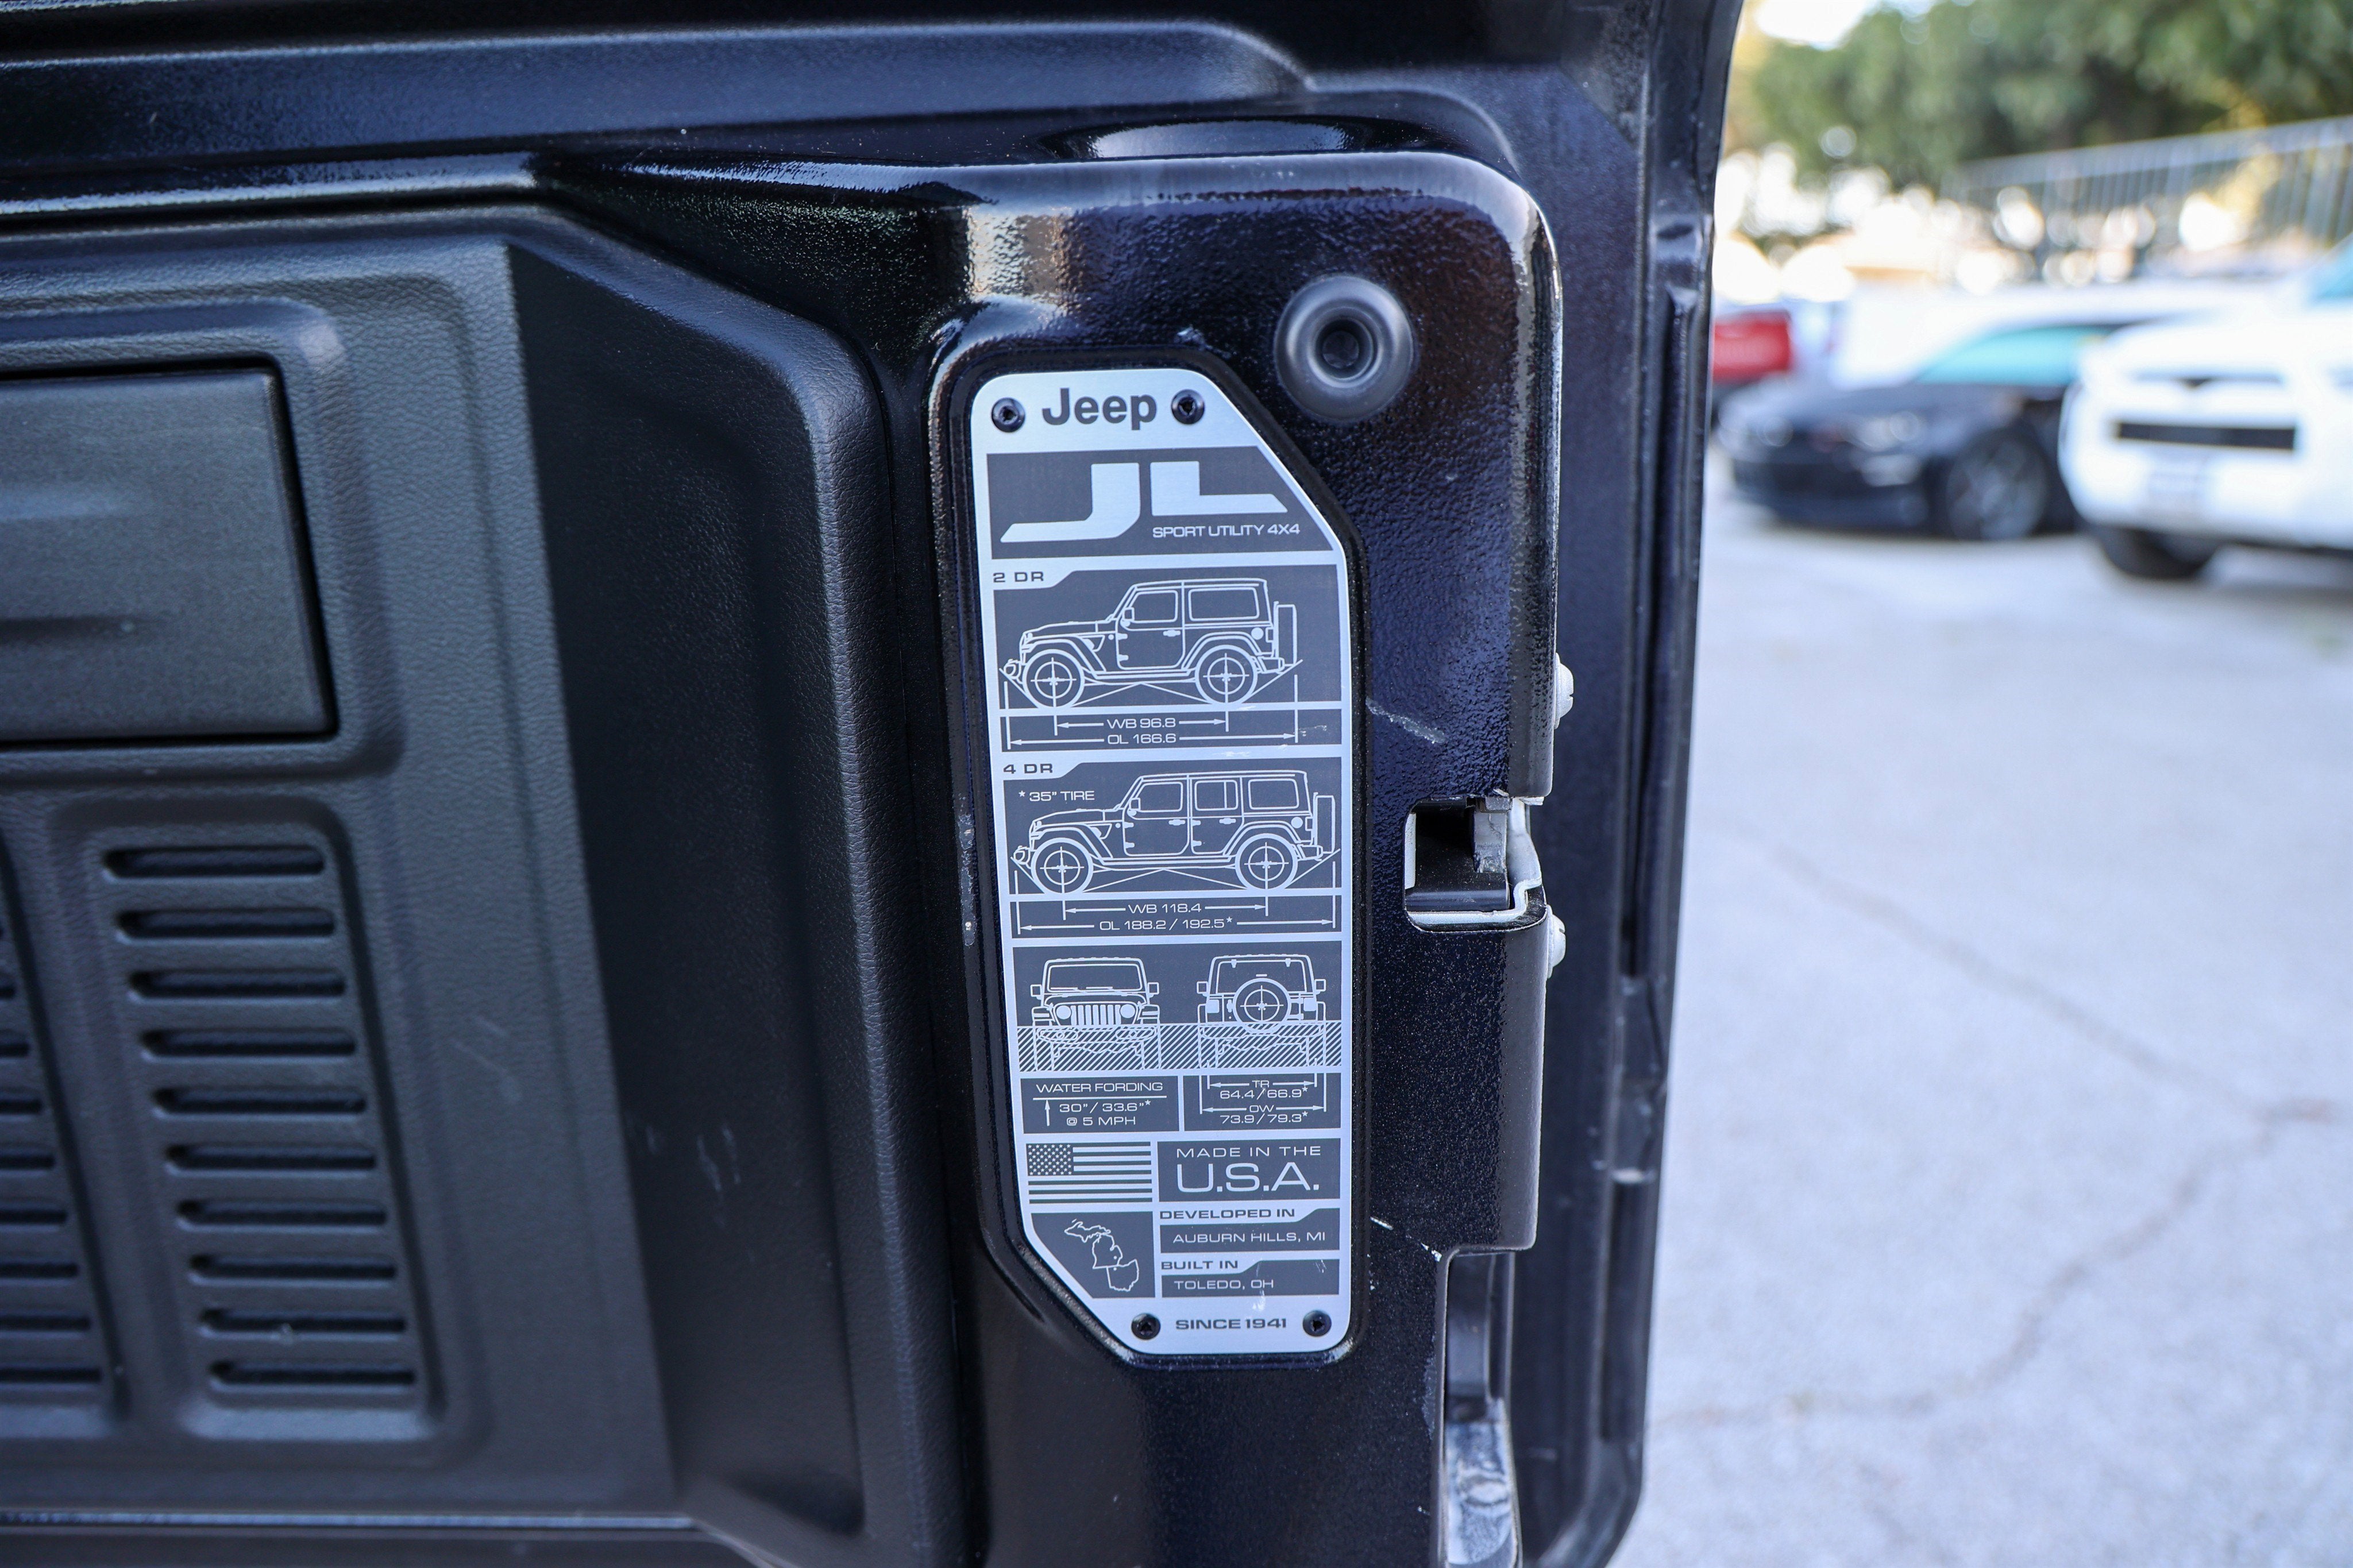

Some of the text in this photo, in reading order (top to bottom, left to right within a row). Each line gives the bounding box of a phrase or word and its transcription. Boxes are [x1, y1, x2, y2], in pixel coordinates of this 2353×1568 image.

[1042, 388, 1158, 431] Jeep
[1000, 461, 1288, 543] JL
[1152, 523, 1301, 538] SPORT UTILITY 4X4
[993, 571, 1044, 583] 2 DR
[1106, 717, 1176, 729] WB 96.8
[1107, 733, 1176, 744] OL 166.6
[1003, 763, 1053, 774] 4 DR
[1060, 790, 1095, 801] TIRE
[1128, 903, 1202, 914] WB 118.4
[1100, 921, 1120, 930] OL
[1124, 920, 1166, 930] 188.2
[1036, 1082, 1163, 1093] WATER FORDING
[1251, 1080, 1270, 1090] TR
[1249, 1104, 1274, 1113] OW
[1066, 1116, 1136, 1126] @ 5 MPH
[1176, 1146, 1321, 1158] MADE IN THE
[1177, 1161, 1320, 1193] U.S.A.
[1159, 1208, 1295, 1219] DEVELOPED IN
[1172, 1231, 1325, 1243] AUBURN HILLS, MI
[1161, 1260, 1238, 1270] BUILT IN
[1174, 1279, 1274, 1290] TOLEDO, OH
[1175, 1318, 1286, 1330] SINCE 1941
